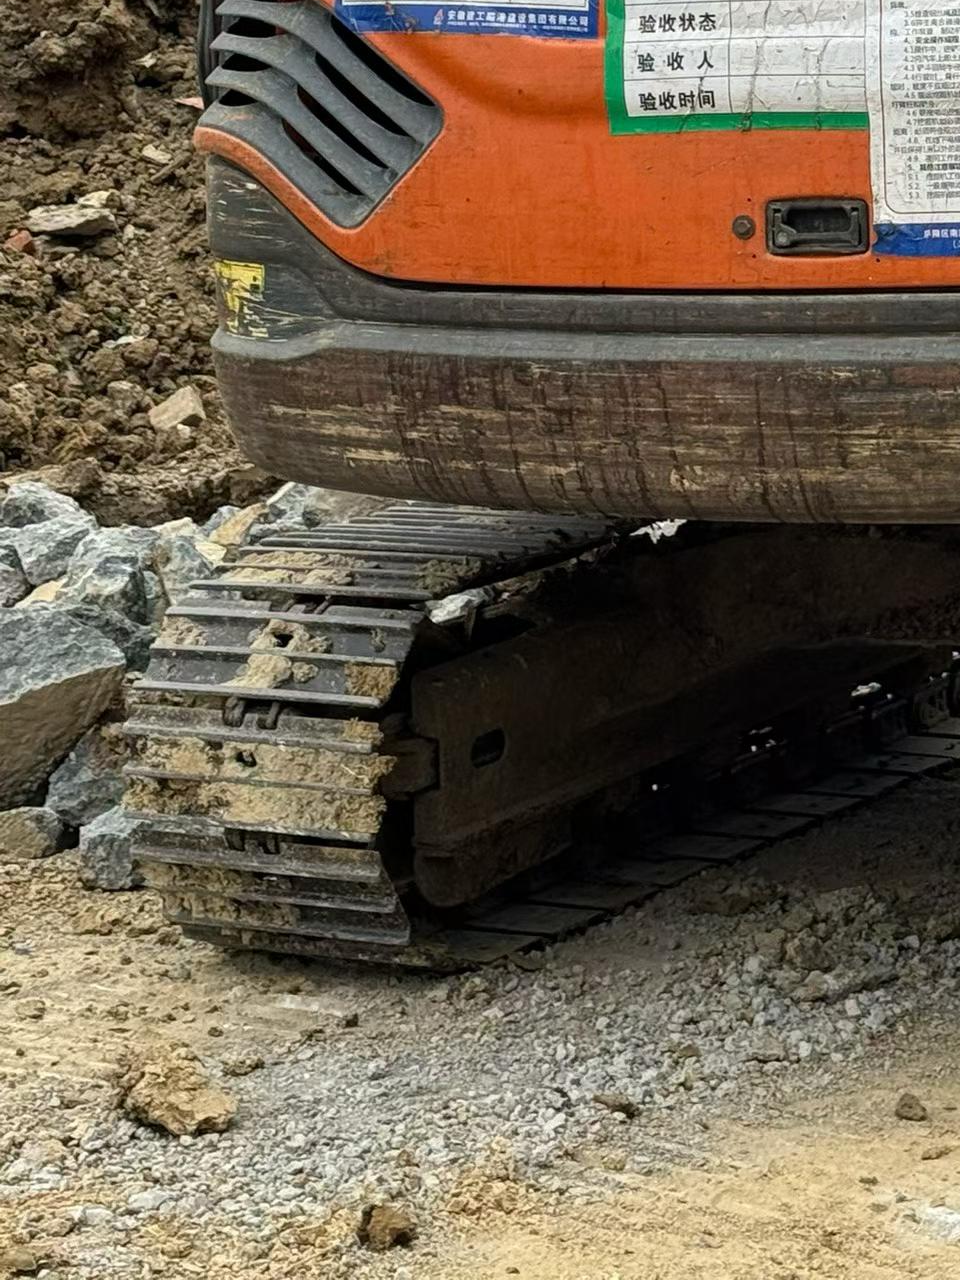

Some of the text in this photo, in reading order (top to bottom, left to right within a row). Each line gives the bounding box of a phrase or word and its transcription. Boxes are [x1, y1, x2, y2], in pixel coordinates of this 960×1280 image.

[447, 9, 588, 27] 安徽建工路港建设集团有限公司
[638, 13, 717, 34] 验收状态
[637, 50, 715, 72] 验收人
[638, 90, 716, 112] 验收时间
